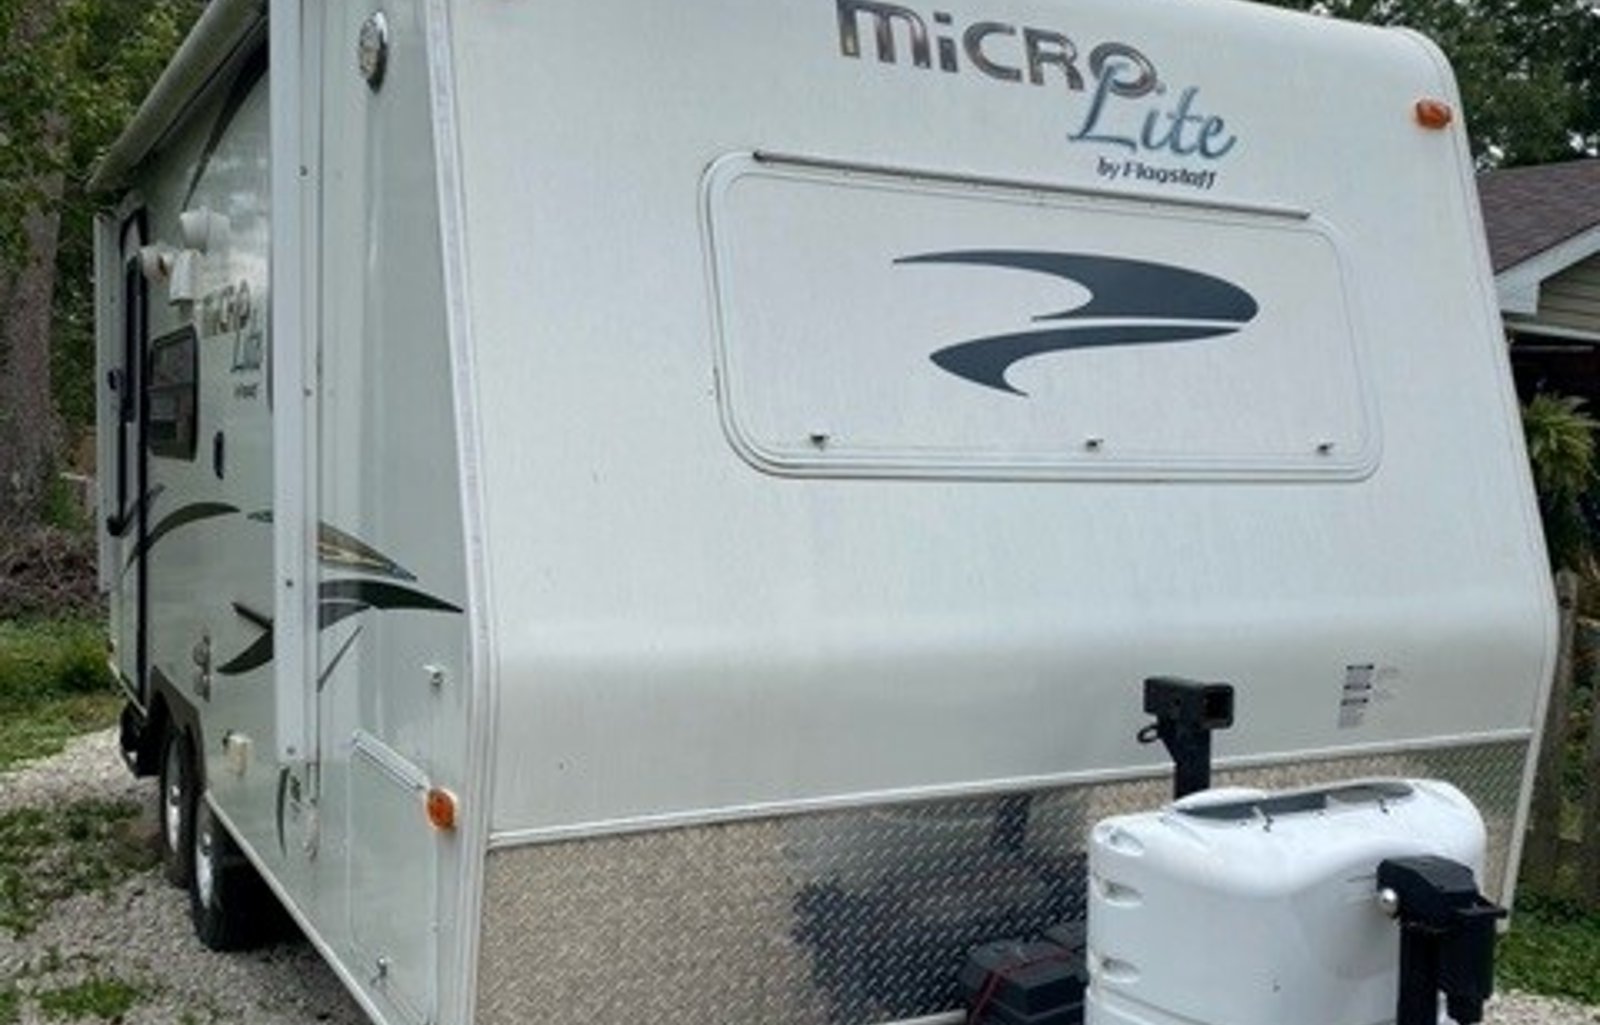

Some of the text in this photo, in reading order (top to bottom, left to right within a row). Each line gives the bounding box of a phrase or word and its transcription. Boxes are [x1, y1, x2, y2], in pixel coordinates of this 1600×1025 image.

[1067, 61, 1237, 159] Lite
[1097, 156, 1217, 190] by Flagstaff
